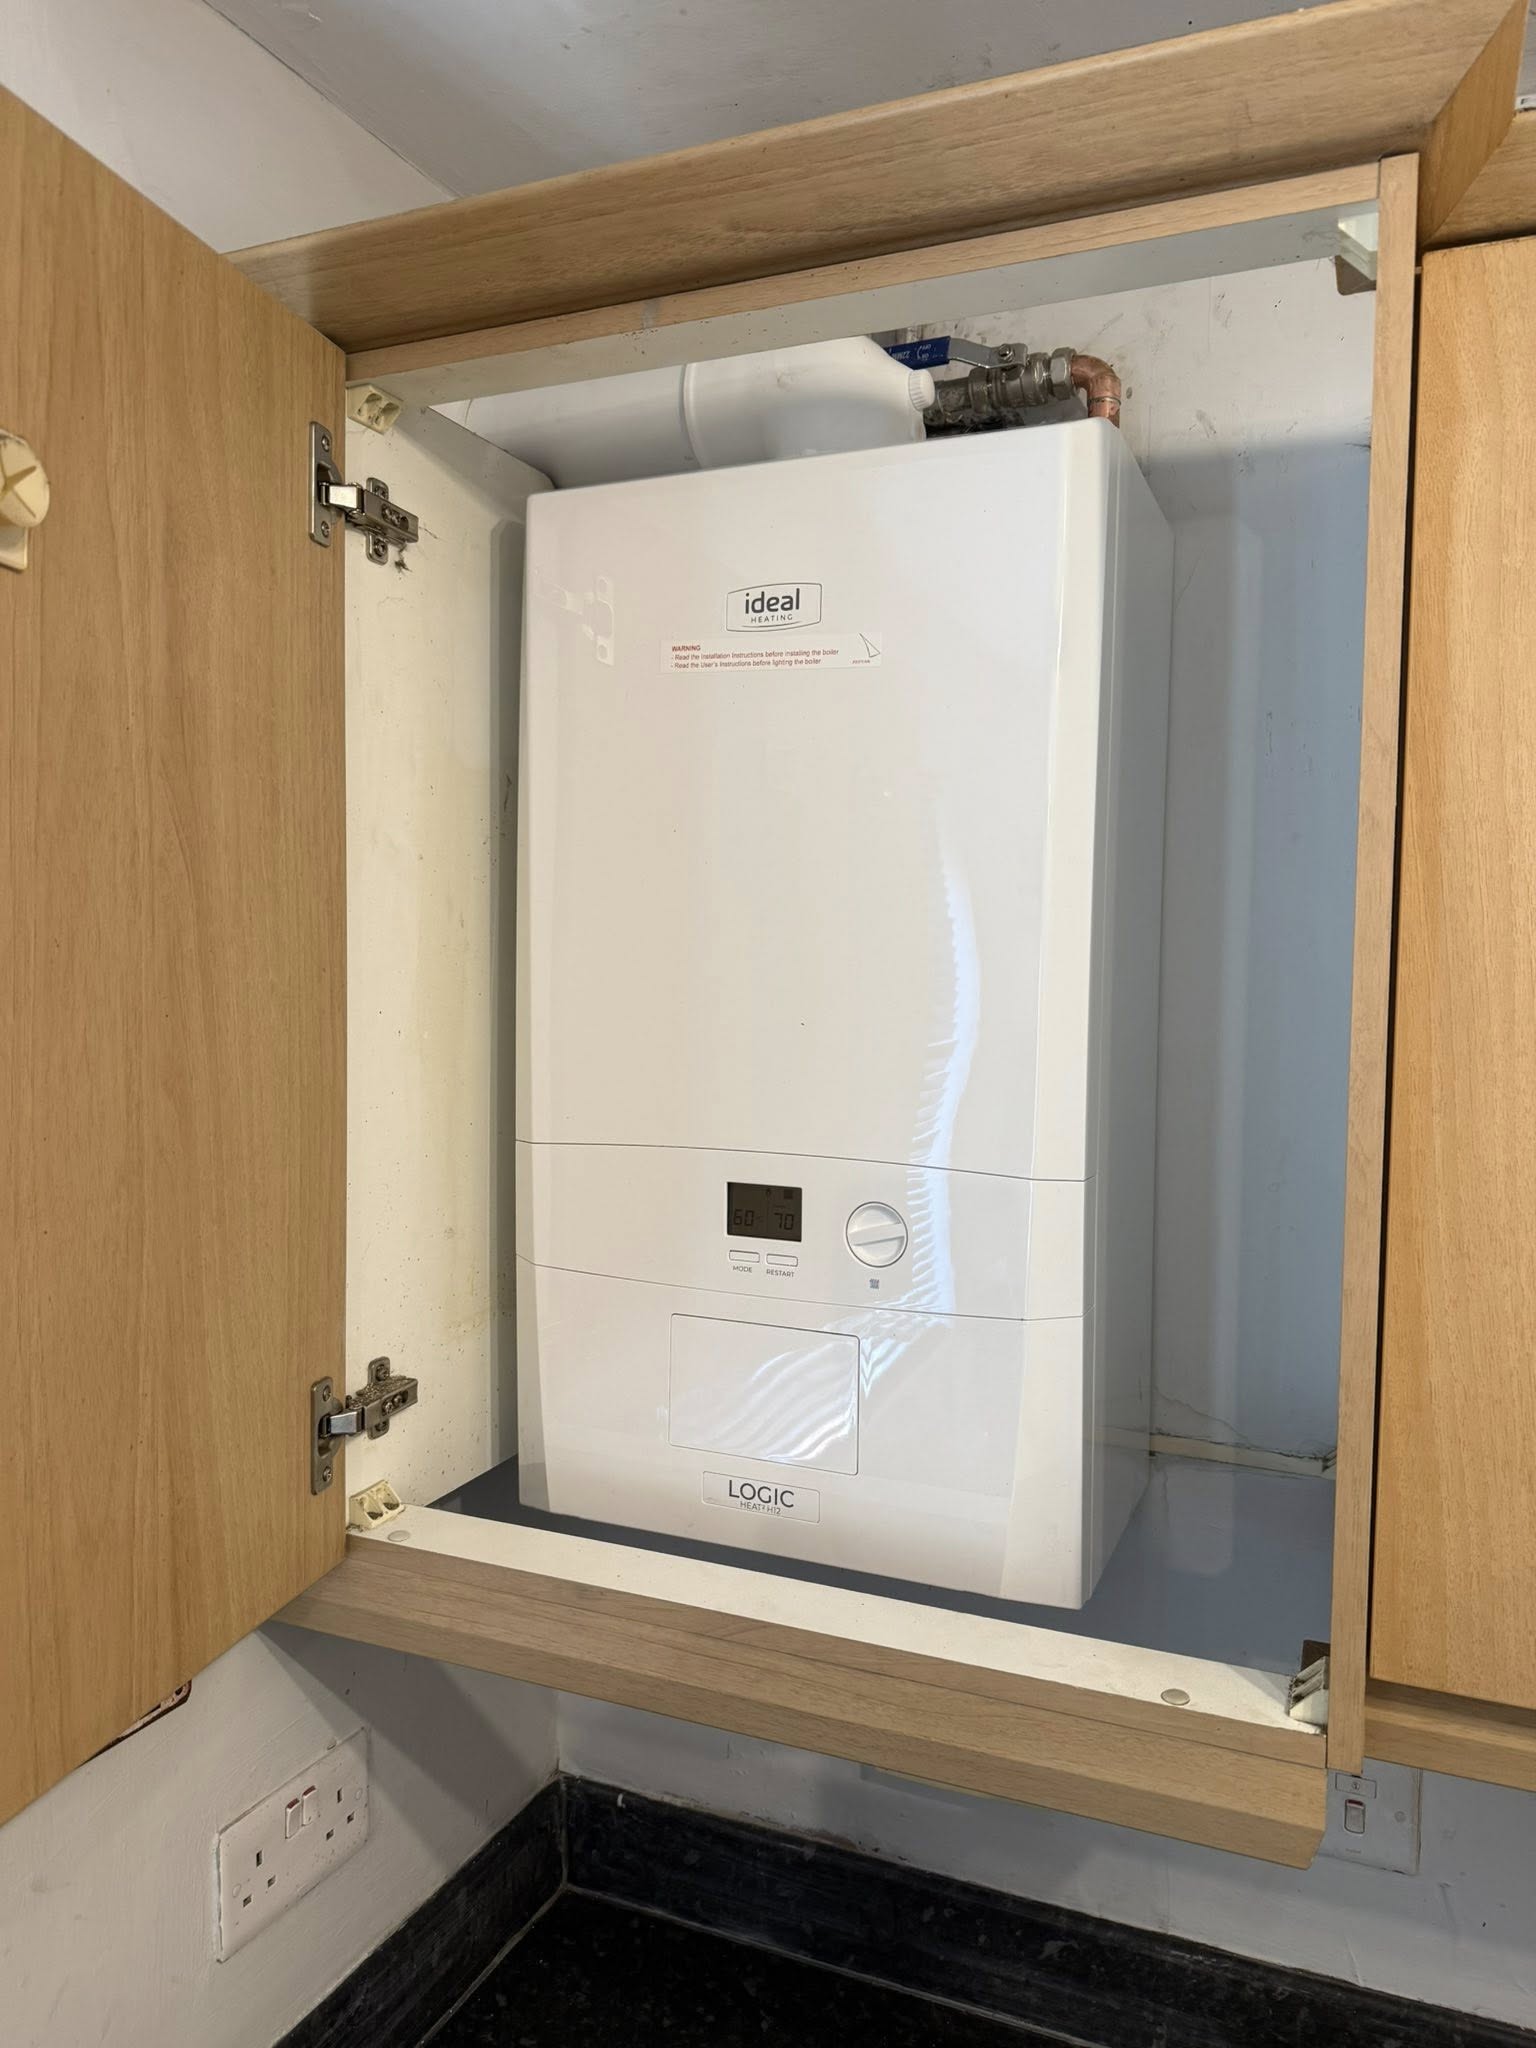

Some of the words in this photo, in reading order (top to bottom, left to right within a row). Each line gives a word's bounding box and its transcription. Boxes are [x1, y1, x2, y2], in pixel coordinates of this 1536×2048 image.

[745, 587, 800, 614] ideal
[751, 613, 793, 624] HEATING
[772, 659, 793, 667] lighting
[733, 1208, 755, 1227] 60
[773, 1212, 794, 1230] 70
[732, 1265, 753, 1274] MODE
[766, 1268, 795, 1278] RESTART
[729, 1479, 795, 1508] LOGIC
